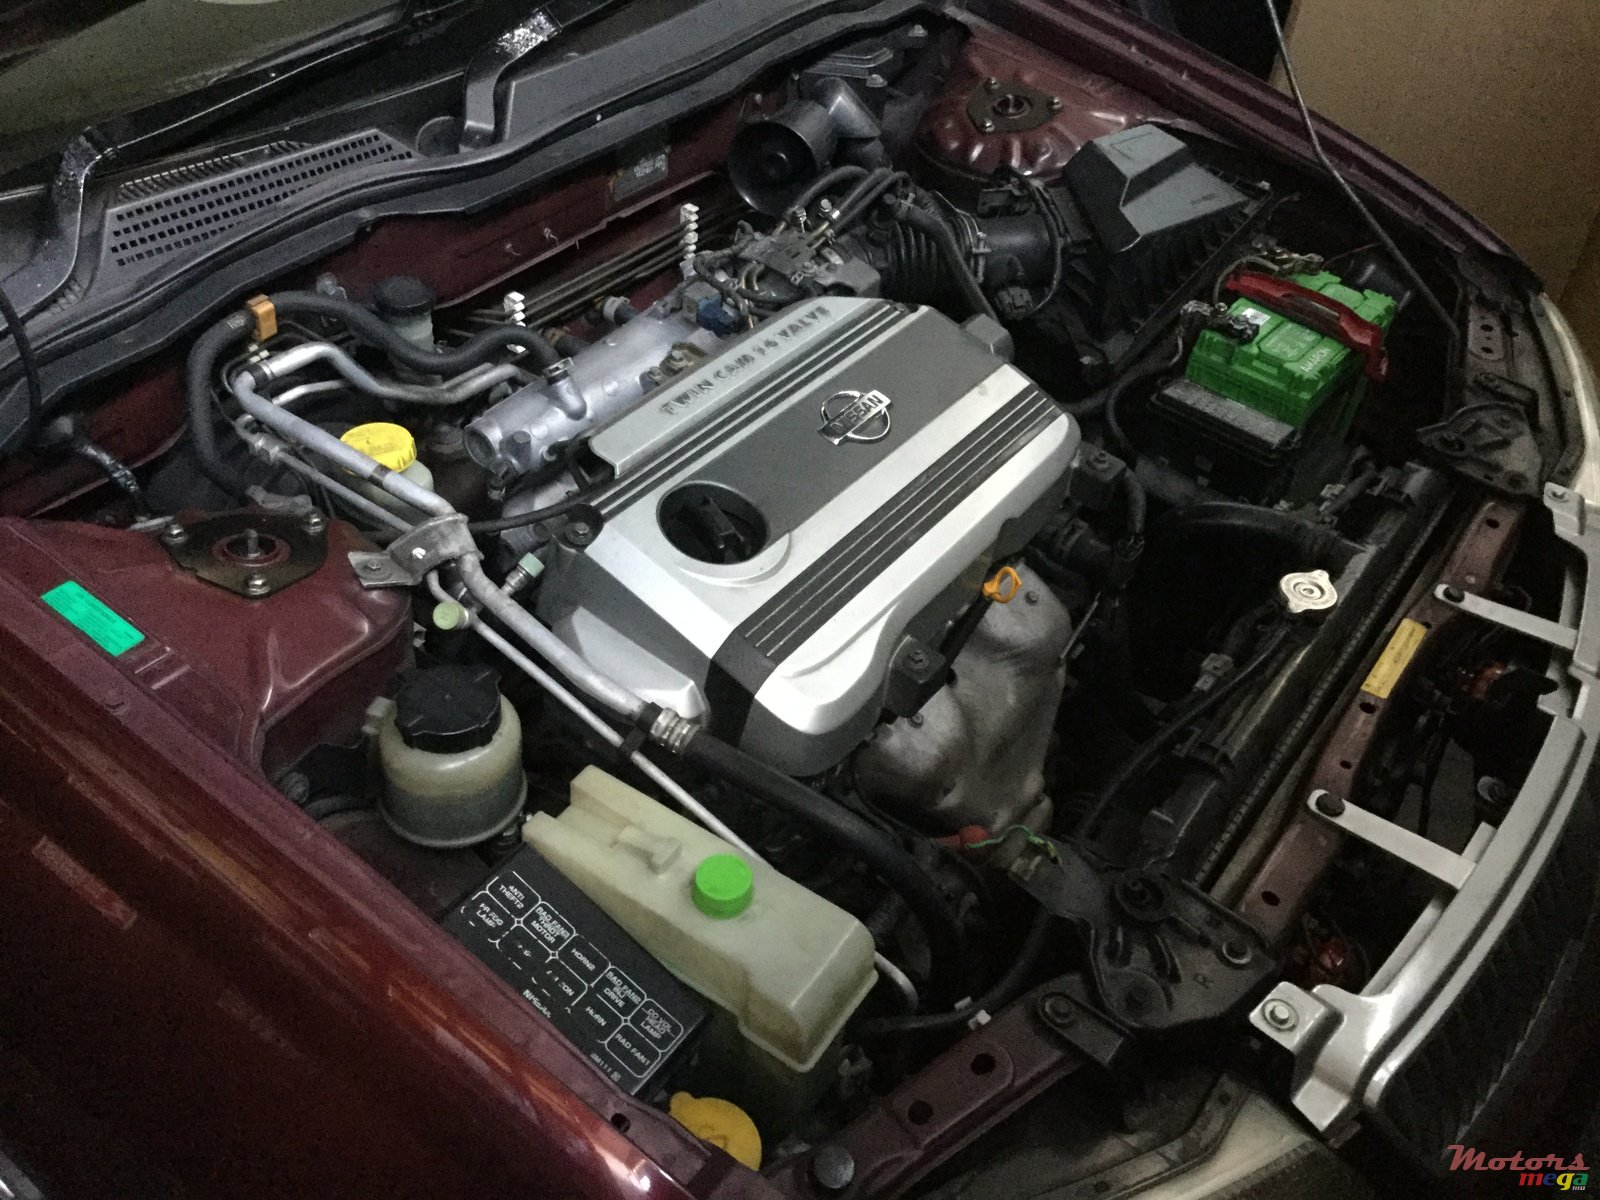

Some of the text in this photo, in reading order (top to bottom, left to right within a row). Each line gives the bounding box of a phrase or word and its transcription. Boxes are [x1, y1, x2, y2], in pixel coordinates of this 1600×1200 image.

[659, 305, 832, 415] TWIN CAM 16 VALVE
[499, 884, 524, 909] THEFT2
[508, 885, 525, 901] ANTI
[488, 911, 504, 926] FOG
[530, 920, 556, 944] MOTOR
[571, 948, 596, 971] HORN2
[603, 987, 625, 1008] DRIVE
[640, 1020, 662, 1039] LAMP
[615, 1033, 650, 1066] RAD FAN1
